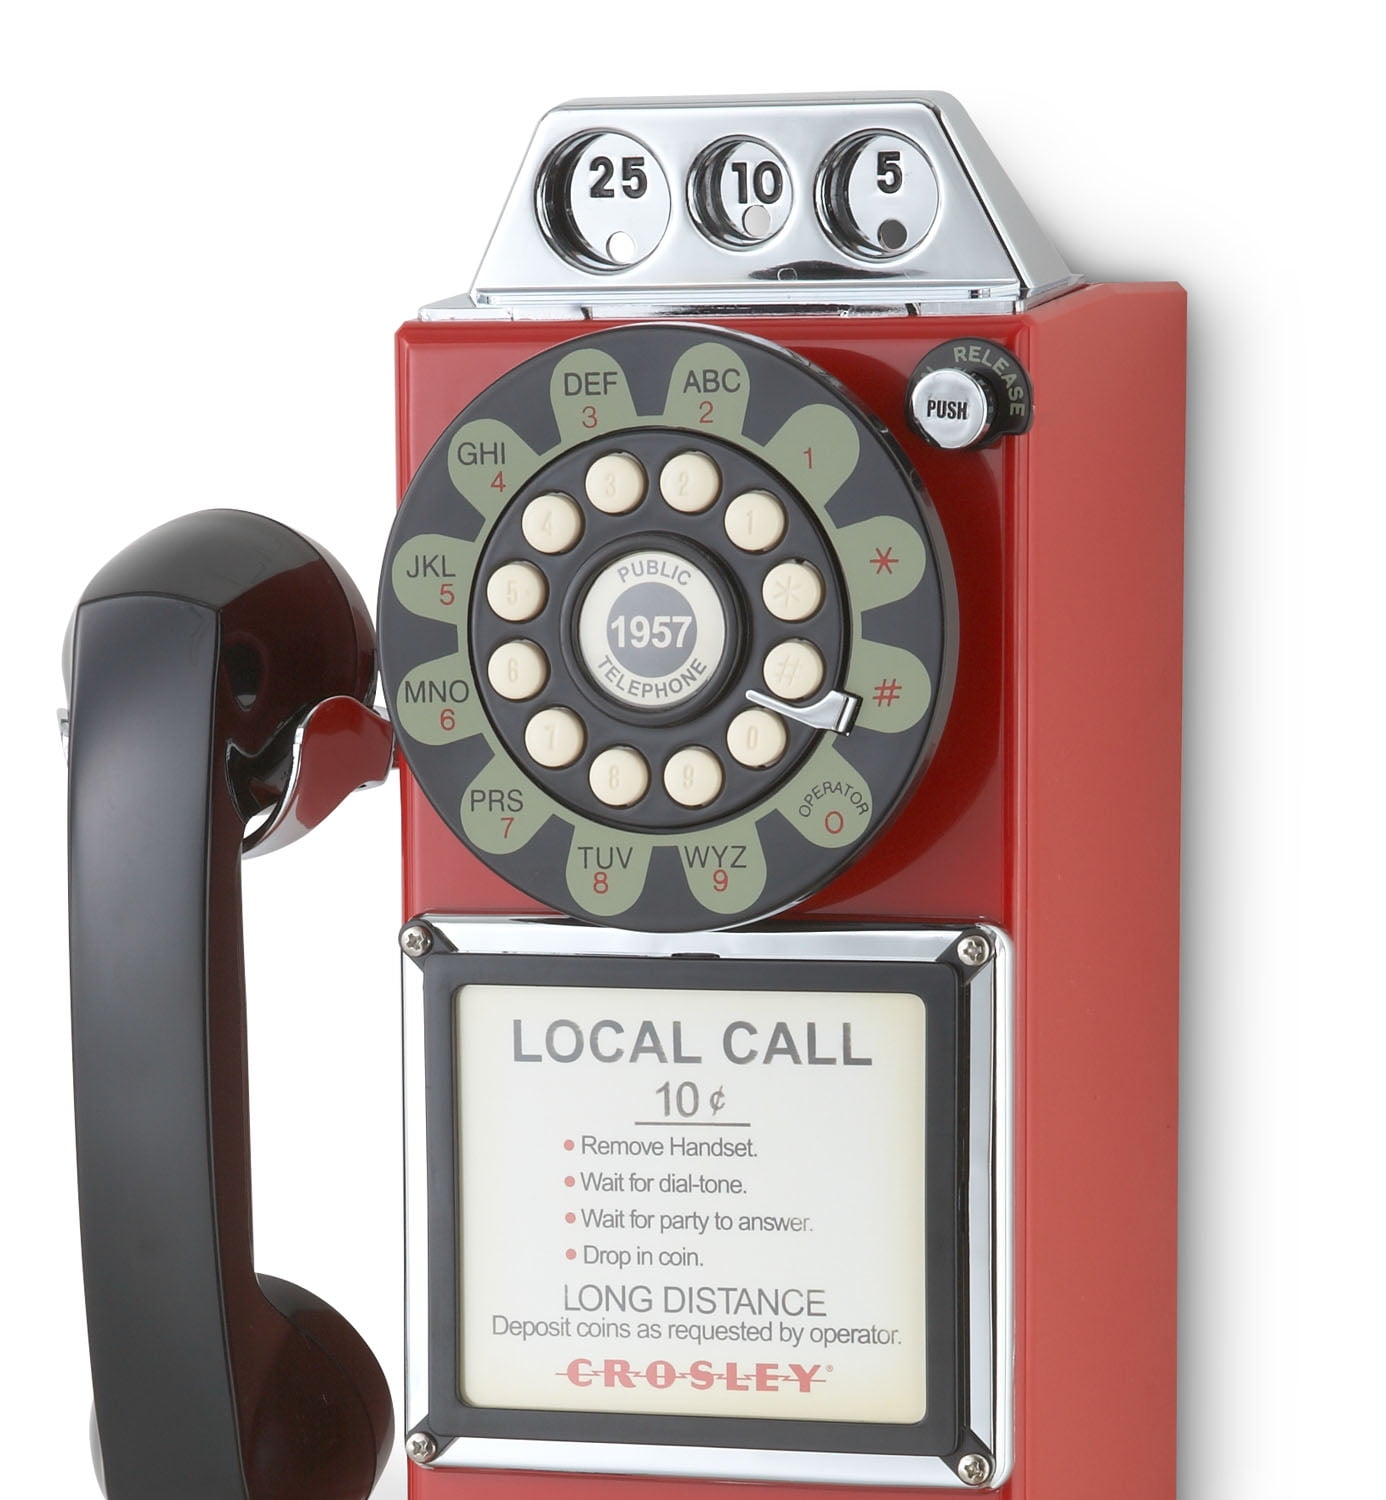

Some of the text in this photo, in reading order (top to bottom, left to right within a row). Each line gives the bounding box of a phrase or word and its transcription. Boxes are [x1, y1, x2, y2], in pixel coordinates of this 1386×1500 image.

[589, 156, 647, 199] 25
[731, 161, 783, 204] 10
[877, 151, 902, 194] 5
[564, 372, 617, 396] DEF
[683, 368, 740, 393] ABC
[953, 345, 1026, 417] RELEASE
[582, 406, 597, 428] 3
[699, 401, 713, 423] 2
[926, 399, 968, 421] PUSH
[458, 442, 505, 465] GHI
[804, 448, 812, 469] 1
[491, 471, 506, 492] 4
[407, 555, 456, 578] JKL
[616, 558, 692, 587] PUBLIC
[440, 584, 455, 605] 5
[611, 616, 692, 648] 1957
[597, 654, 708, 700] TELEPHONE
[405, 680, 469, 703] MNO
[441, 709, 455, 731] 6
[471, 789, 523, 812] PRS
[799, 780, 870, 818] OPERATOR
[501, 817, 514, 839] 7
[578, 847, 633, 869] TUV
[684, 846, 746, 868] WYZ
[594, 872, 608, 894] 8
[713, 869, 728, 892] 9
[514, 1019, 872, 1065] LOCAL CALL
[656, 1081, 699, 1117] 10
[582, 1136, 757, 1157] Remove Handset.
[580, 1172, 746, 1193] Wait for dial-tone.
[581, 1209, 812, 1235] Wait for party to answer.
[584, 1245, 703, 1269] Drop in coin.
[565, 1285, 826, 1316] LONG DISTANCE
[493, 1315, 901, 1348] Deposit coins as requested by operator.
